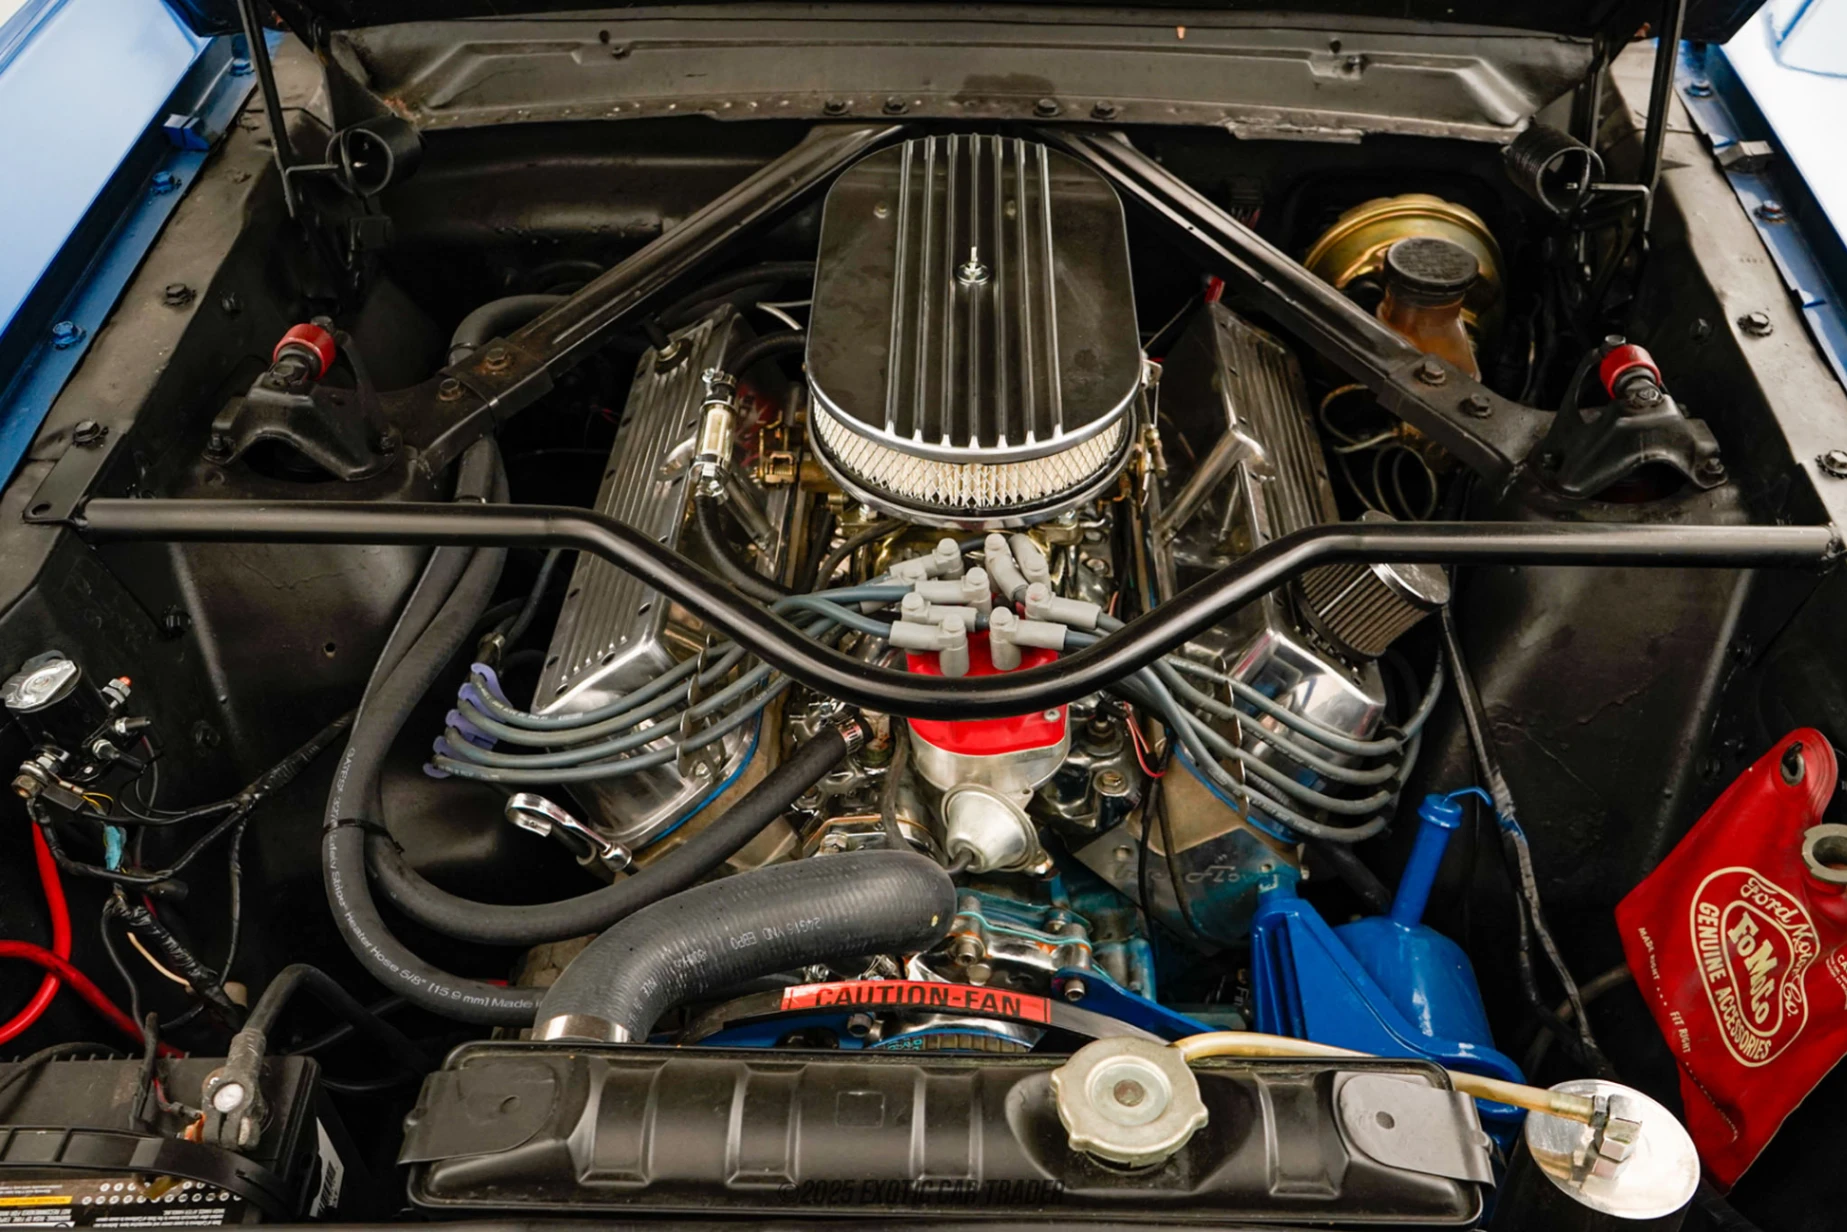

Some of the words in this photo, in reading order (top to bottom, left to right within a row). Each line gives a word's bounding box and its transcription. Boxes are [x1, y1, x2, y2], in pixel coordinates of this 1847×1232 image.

[344, 911, 372, 948] Heater
[369, 946, 399, 972] Hose
[491, 997, 534, 1009] Made
[1697, 901, 1727, 984] GENUINE
[1714, 986, 1772, 1060] ACCESSORIES
[1740, 877, 1799, 924] Ford
[1783, 976, 1803, 1017] Co.
[815, 984, 1021, 1018] CAUTION-FAN
[1669, 1010, 1685, 1026] FIT
[1678, 1027, 1691, 1053] RIGHT
